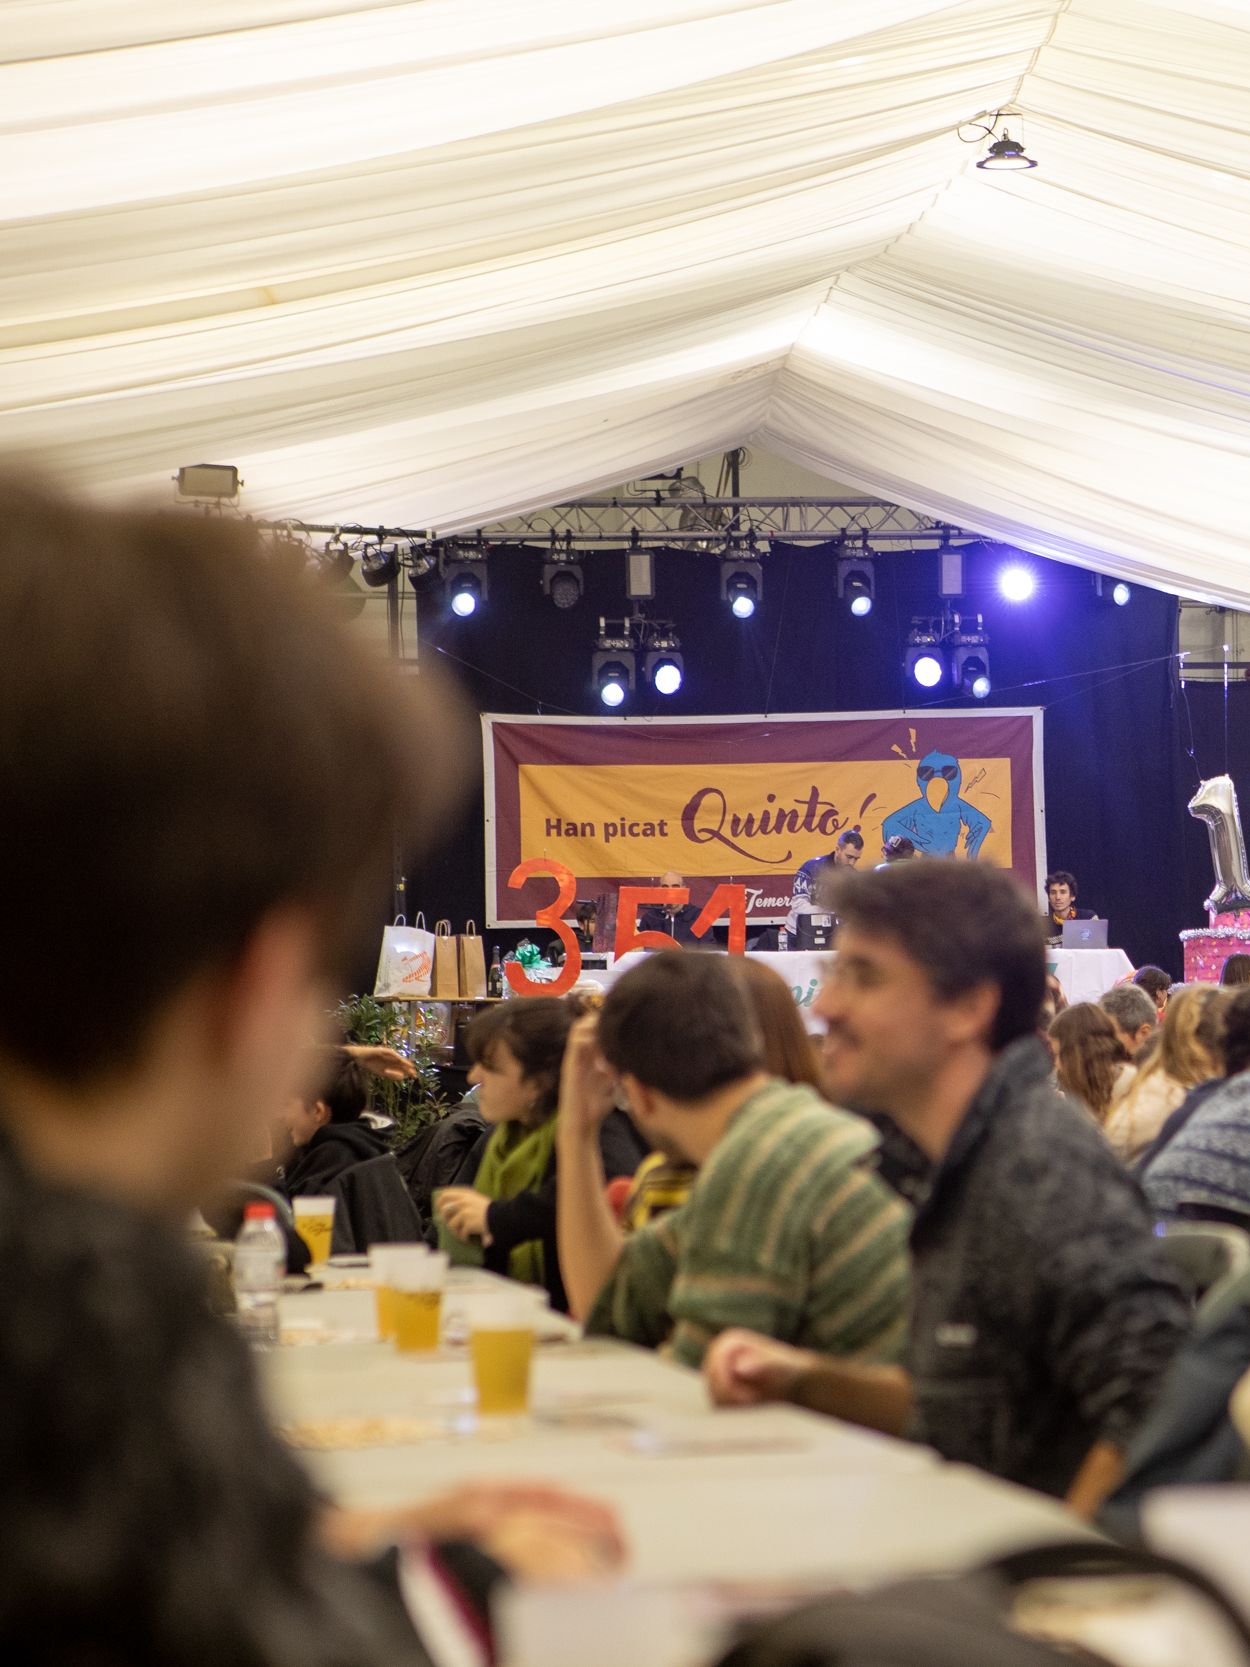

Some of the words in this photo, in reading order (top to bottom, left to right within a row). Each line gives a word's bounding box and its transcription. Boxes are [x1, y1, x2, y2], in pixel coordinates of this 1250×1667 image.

[545, 818, 596, 838] Han
[603, 817, 669, 843] picat
[680, 784, 877, 864] Quinto!
